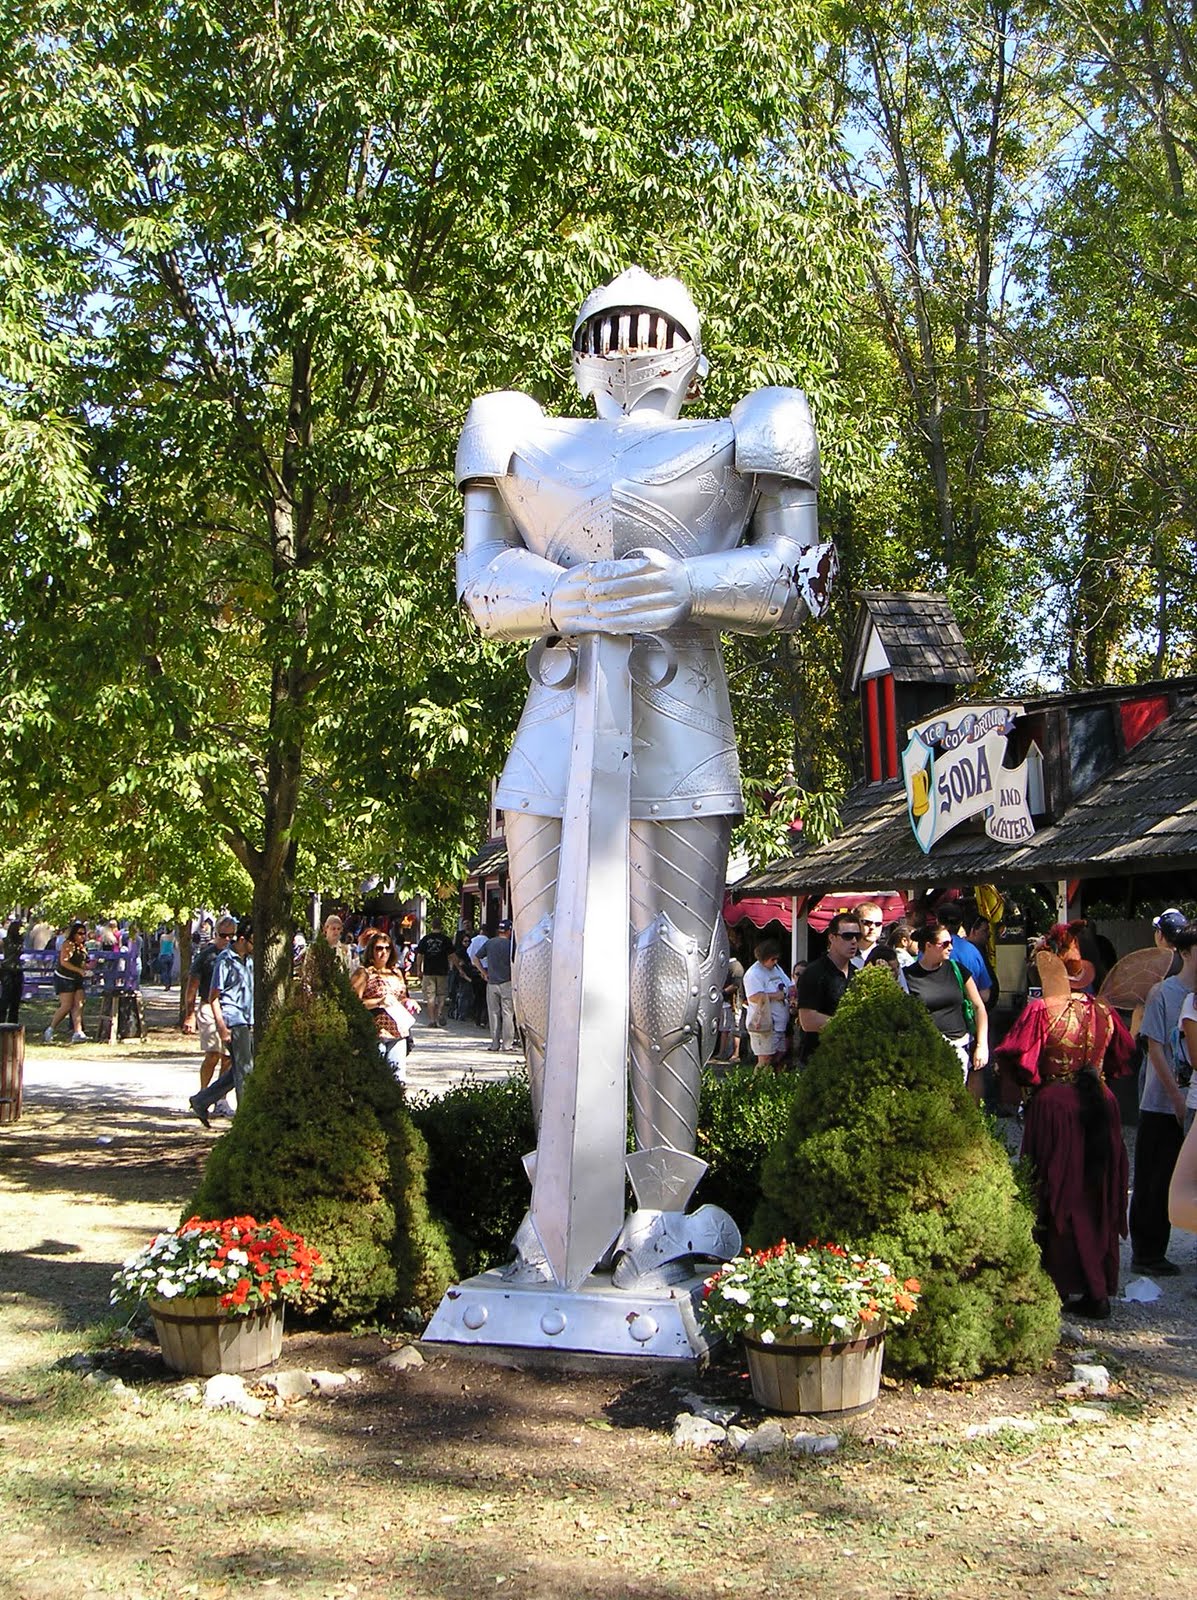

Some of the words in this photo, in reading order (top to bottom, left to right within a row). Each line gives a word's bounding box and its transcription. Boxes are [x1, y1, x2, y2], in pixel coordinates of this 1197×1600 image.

[945, 719, 970, 747] COLD
[938, 745, 993, 814] SODA
[1000, 788, 1021, 808] AND
[990, 817, 1030, 839] WATER
